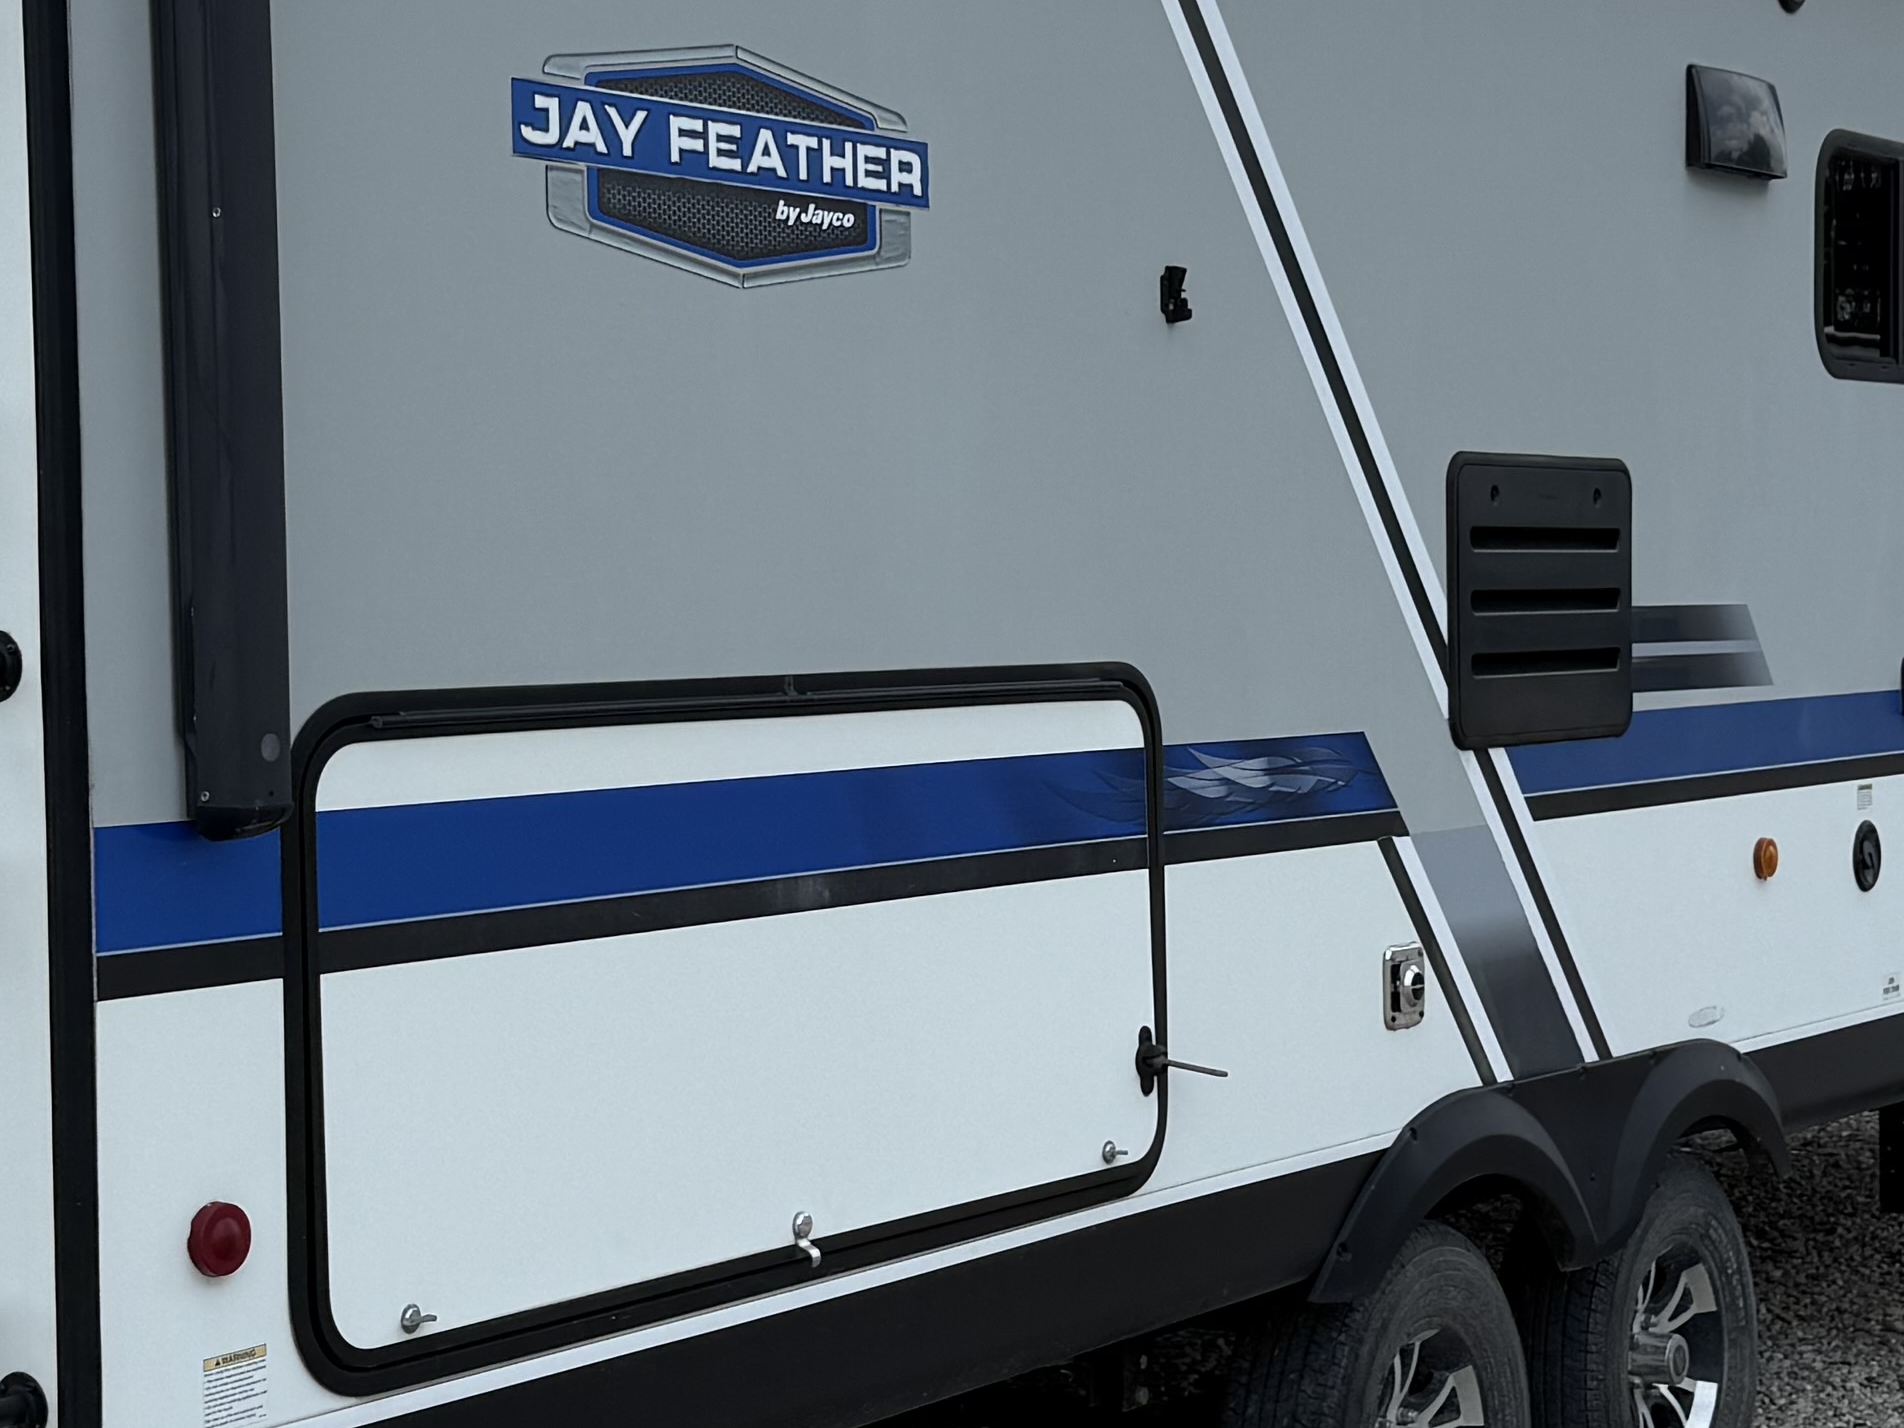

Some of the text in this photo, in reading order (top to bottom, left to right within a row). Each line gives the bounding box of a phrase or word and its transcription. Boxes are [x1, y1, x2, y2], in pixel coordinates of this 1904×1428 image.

[519, 93, 924, 198] JAY FEATHER
[775, 200, 855, 230] by Jayco
